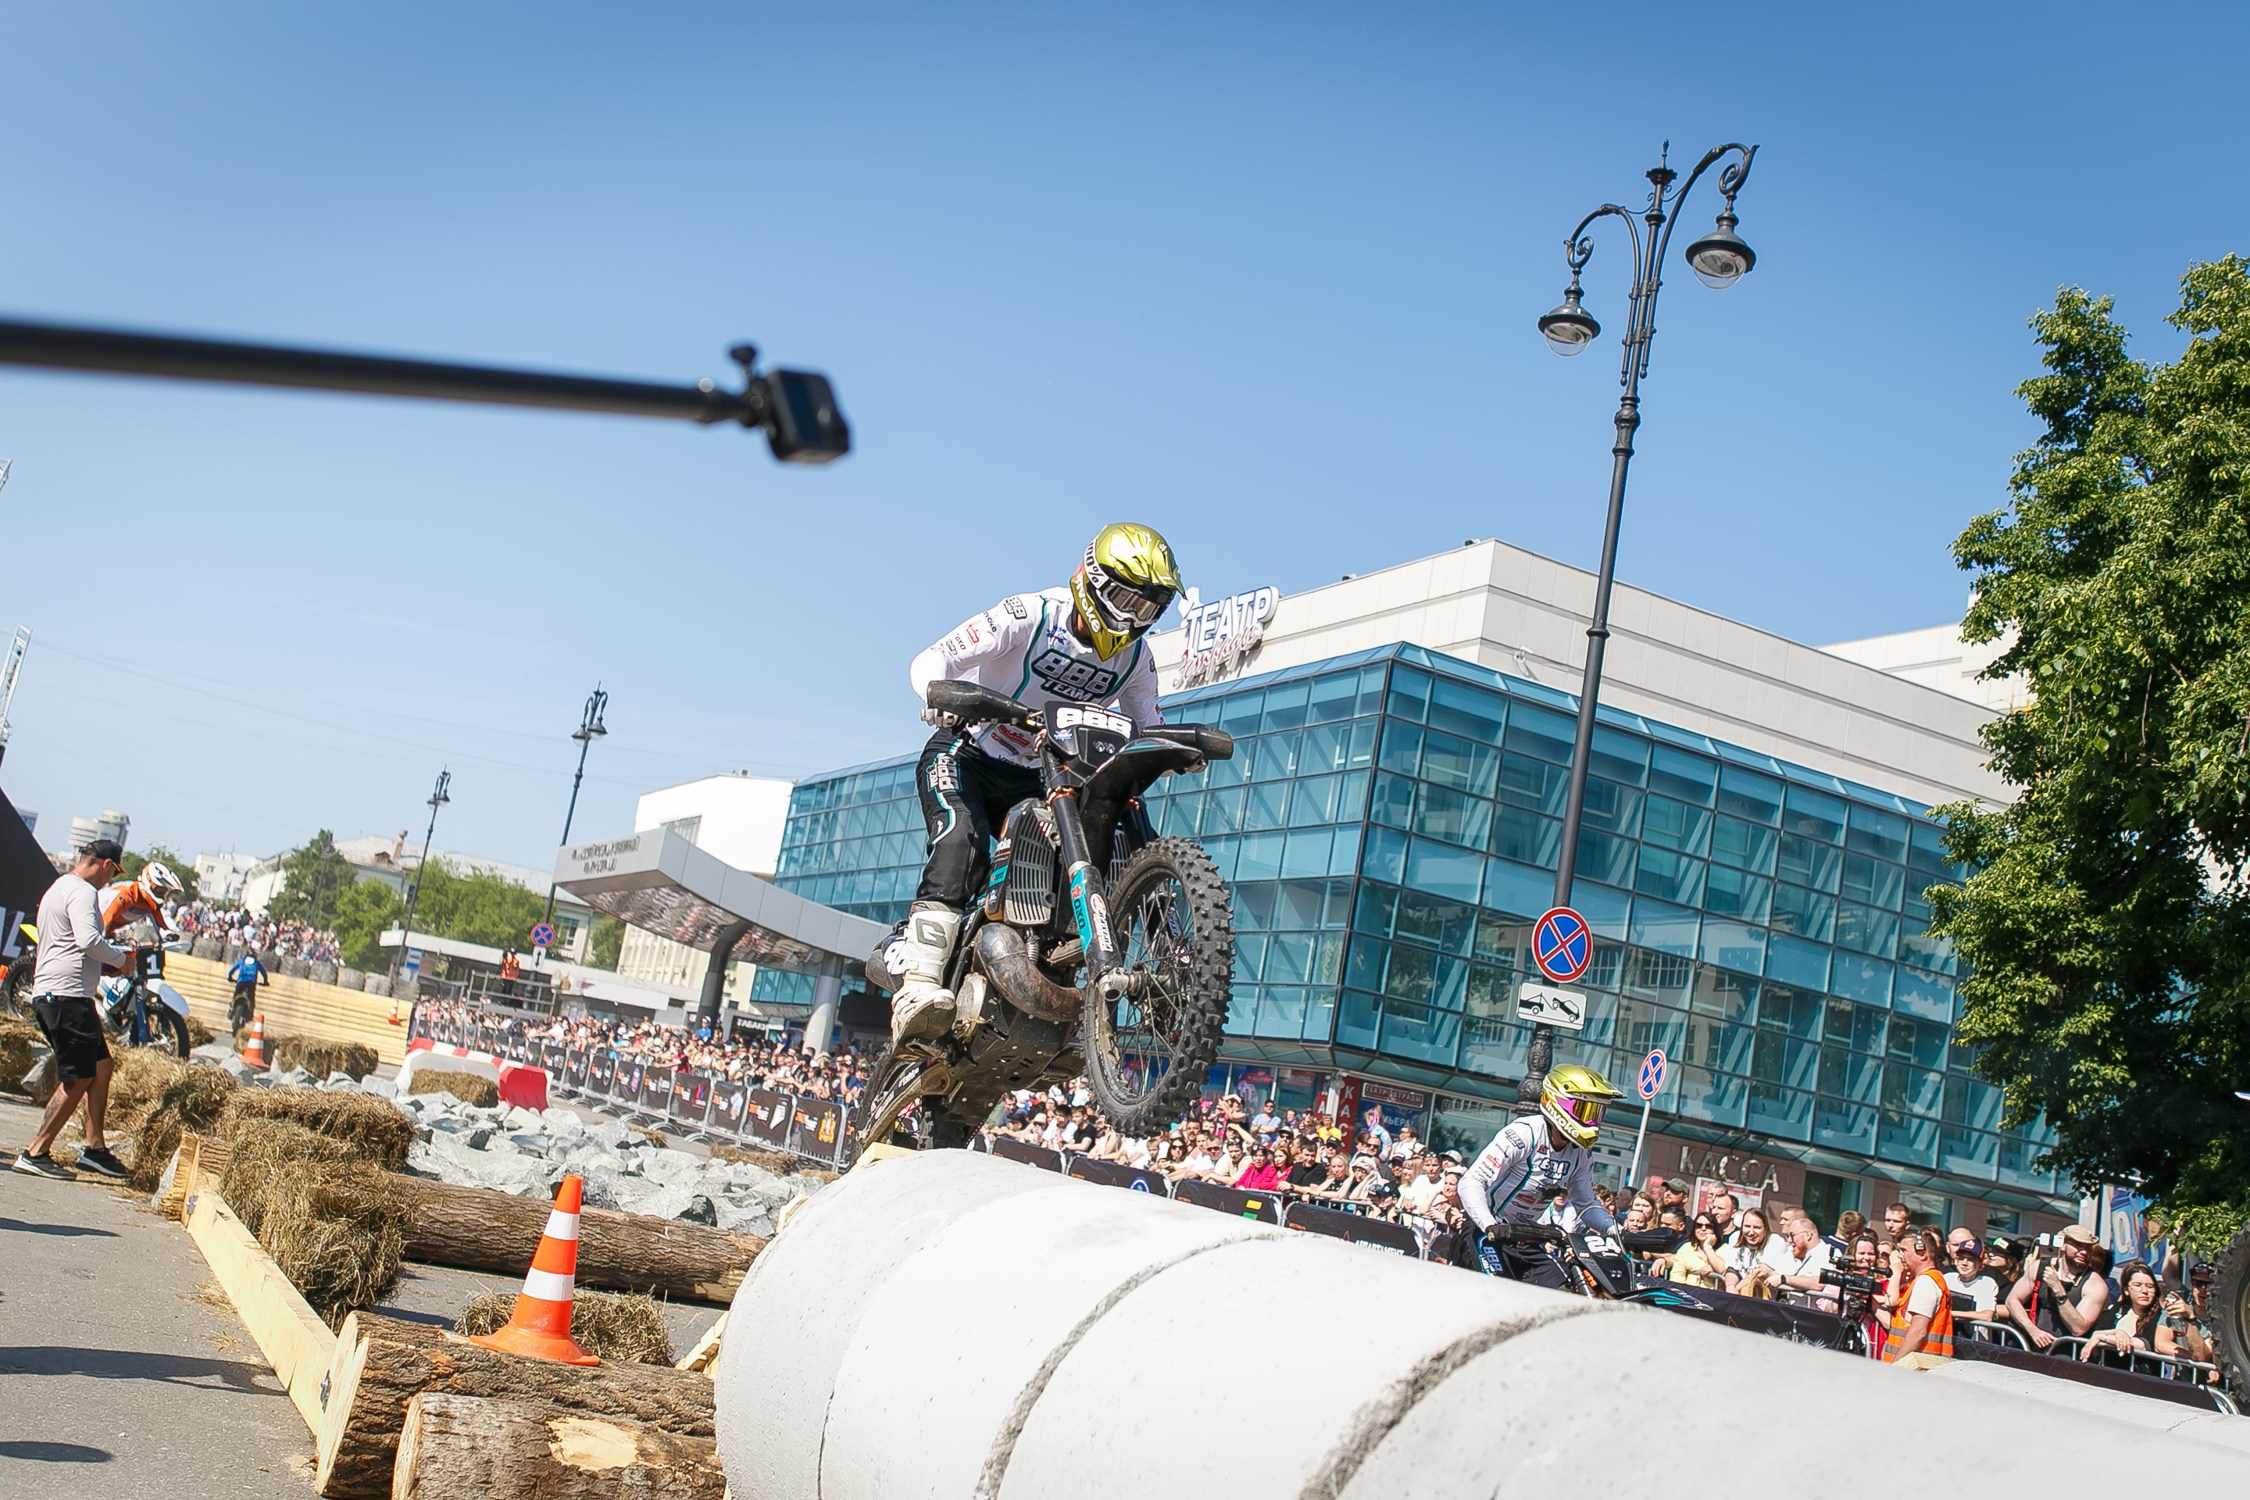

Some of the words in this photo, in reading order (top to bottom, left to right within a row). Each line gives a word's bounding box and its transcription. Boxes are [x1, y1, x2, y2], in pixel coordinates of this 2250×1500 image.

[1187, 586, 1274, 653] ТЕАТР
[1034, 651, 1114, 694] 888
[1044, 676, 1094, 701] TEAM
[1057, 707, 1132, 740] 888
[146, 954, 161, 975] 1
[1680, 1145, 1780, 1193] КАССА
